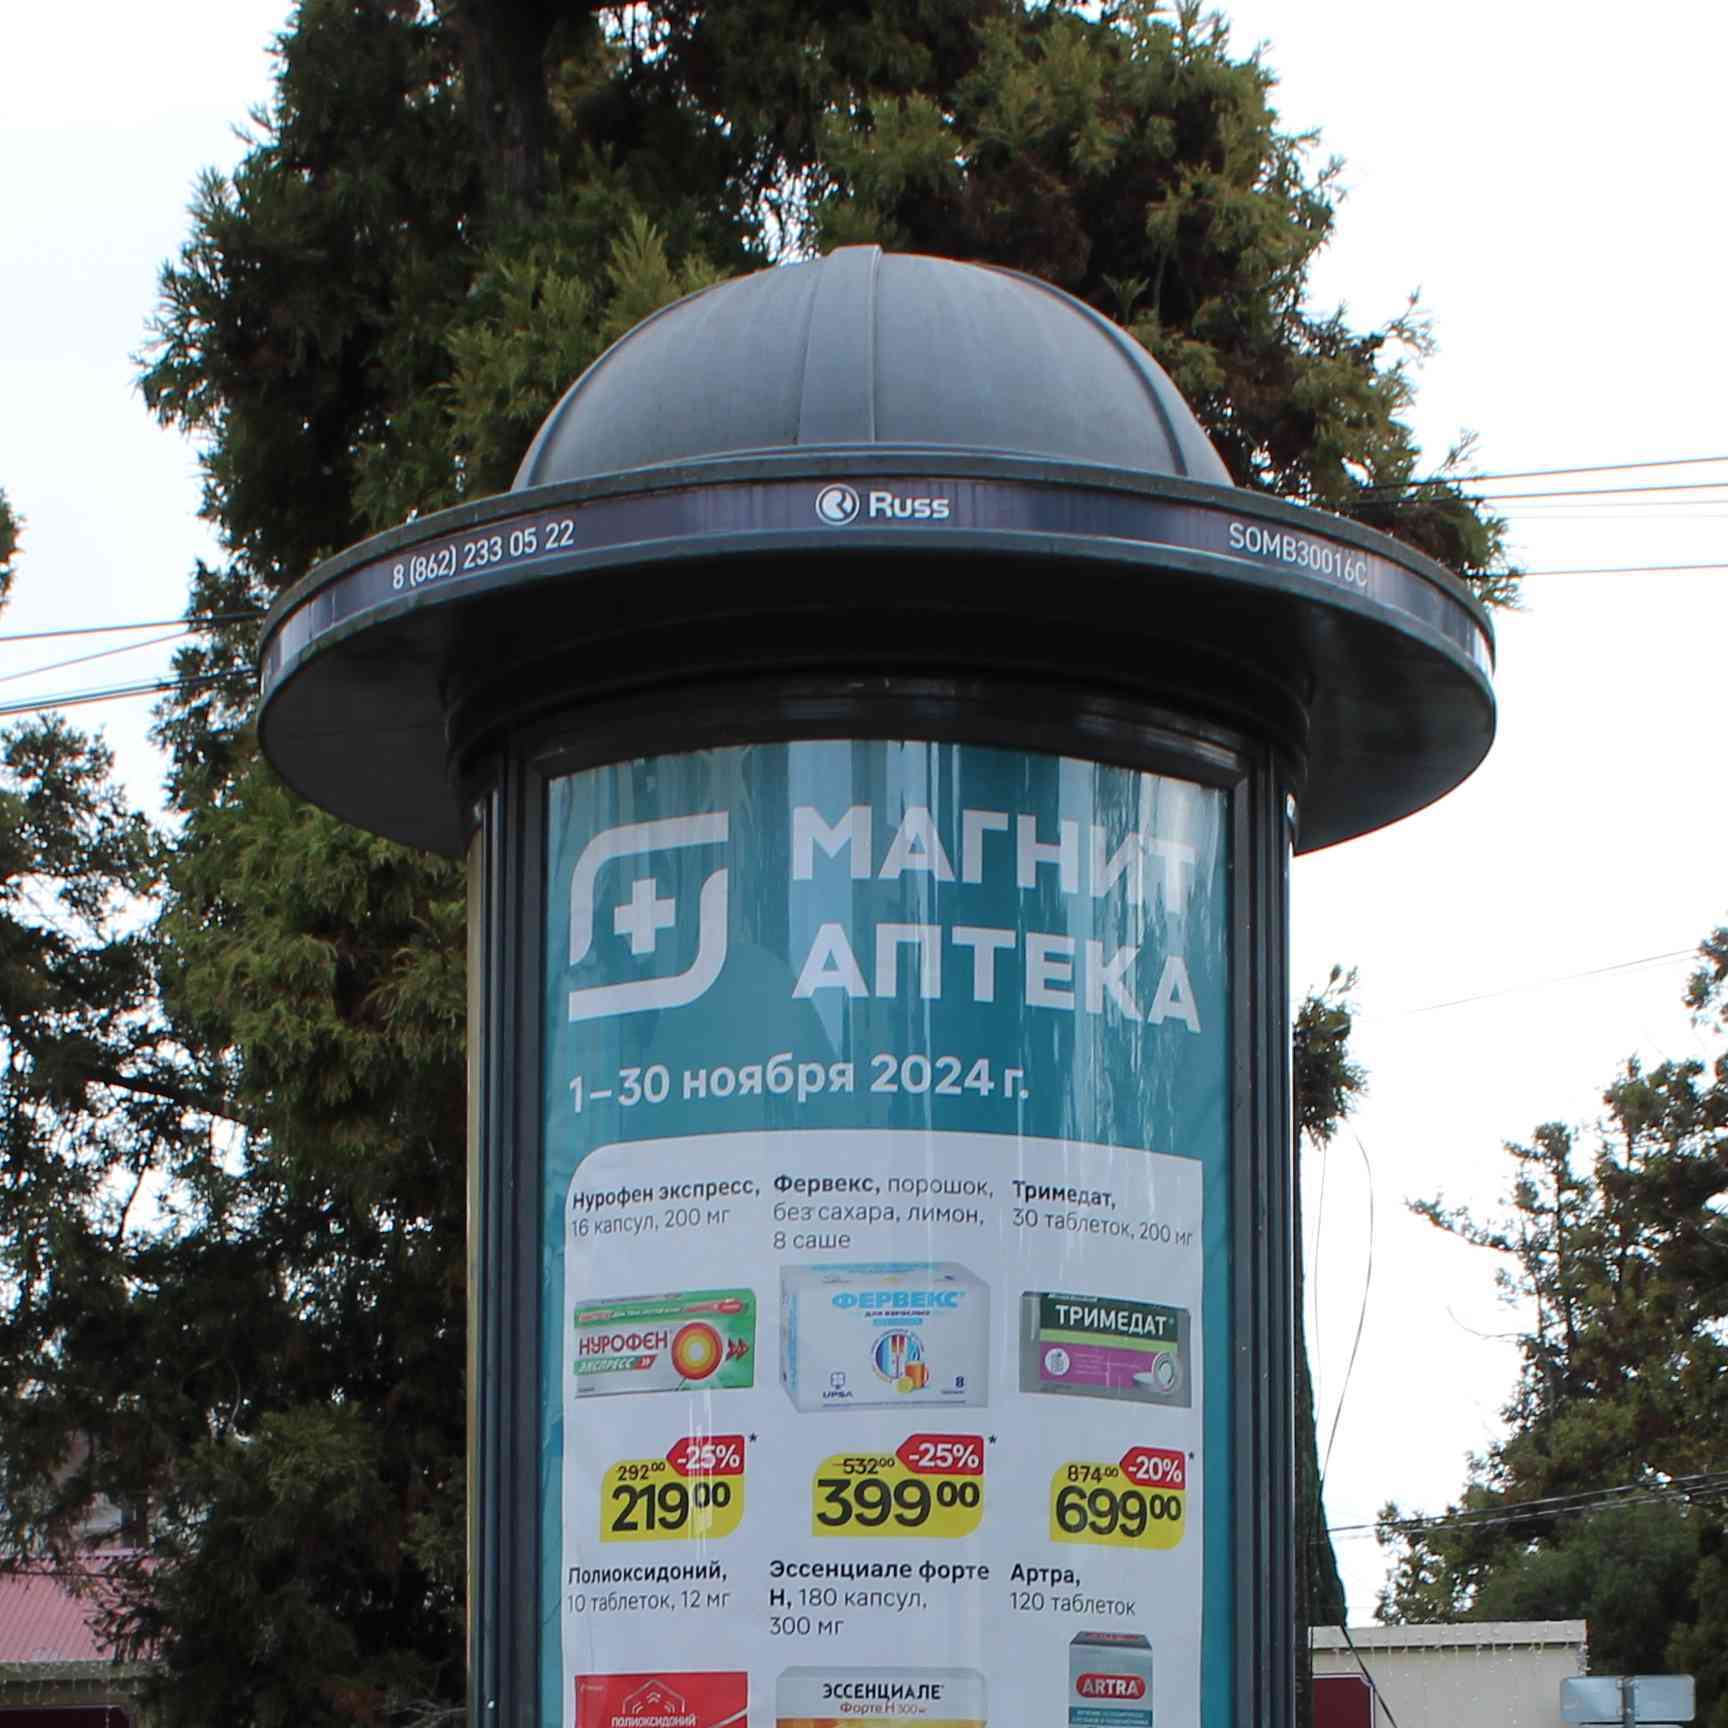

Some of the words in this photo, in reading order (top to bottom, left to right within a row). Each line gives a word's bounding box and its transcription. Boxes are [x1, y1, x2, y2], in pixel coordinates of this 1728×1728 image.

[869, 491, 950, 518] Russ
[393, 564, 405, 589] 8
[410, 544, 457, 586] (862)
[463, 536, 502, 569] 233
[510, 527, 537, 556] 05
[545, 520, 574, 549] 22
[791, 804, 1198, 915] МАГНИТ
[791, 923, 1202, 1034] АПТЕКА
[682, 1052, 855, 1103] ноября
[871, 1055, 995, 1098] 2024
[1003, 1067, 1030, 1100] г.
[572, 1187, 654, 1211] Нурофен
[659, 1179, 761, 1204] экспресс,
[773, 1174, 880, 1199] Фервекс,
[887, 1176, 993, 1200] порошок,
[1012, 1180, 1116, 1209] Тримедат,
[594, 1212, 659, 1236] капсул,
[664, 1208, 701, 1228] 200
[707, 1208, 730, 1225] мг
[773, 1202, 813, 1222] без
[818, 1205, 901, 1226] сахара,
[907, 1206, 984, 1226] лимон,
[1012, 1208, 1038, 1228] 30
[1046, 1211, 1135, 1240] таблеток,
[1140, 1222, 1171, 1244] 200
[1175, 1228, 1193, 1247] мг
[773, 1232, 786, 1250] 8
[792, 1233, 851, 1250] саше
[832, 1288, 960, 1309] ФЕРВЕКС
[1055, 1304, 1167, 1336] ТРИМЕДАТ
[578, 1329, 669, 1356] НУРОФЕН
[579, 1357, 634, 1374] ЭКСПРЕСС
[677, 1444, 740, 1470] -25%
[908, 1444, 980, 1470] -25%
[1127, 1456, 1183, 1484] -20%
[568, 1560, 728, 1586] Полиоксидоний,
[769, 1559, 913, 1582] Эссенциале
[918, 1561, 990, 1584] форте
[1010, 1563, 1082, 1588] Артра,
[591, 1590, 675, 1612] таблеток,
[680, 1590, 702, 1608] 12
[706, 1590, 731, 1609] мг
[799, 1587, 838, 1607] 180
[844, 1589, 928, 1613] капсул,
[1010, 1591, 1045, 1612] 120
[1051, 1592, 1136, 1617] таблеток
[769, 1616, 811, 1636] 300
[817, 1617, 845, 1636] мг
[823, 1682, 943, 1702] ЭССЕНЦИАЛЕ
[1082, 1679, 1139, 1696] ARTRA
